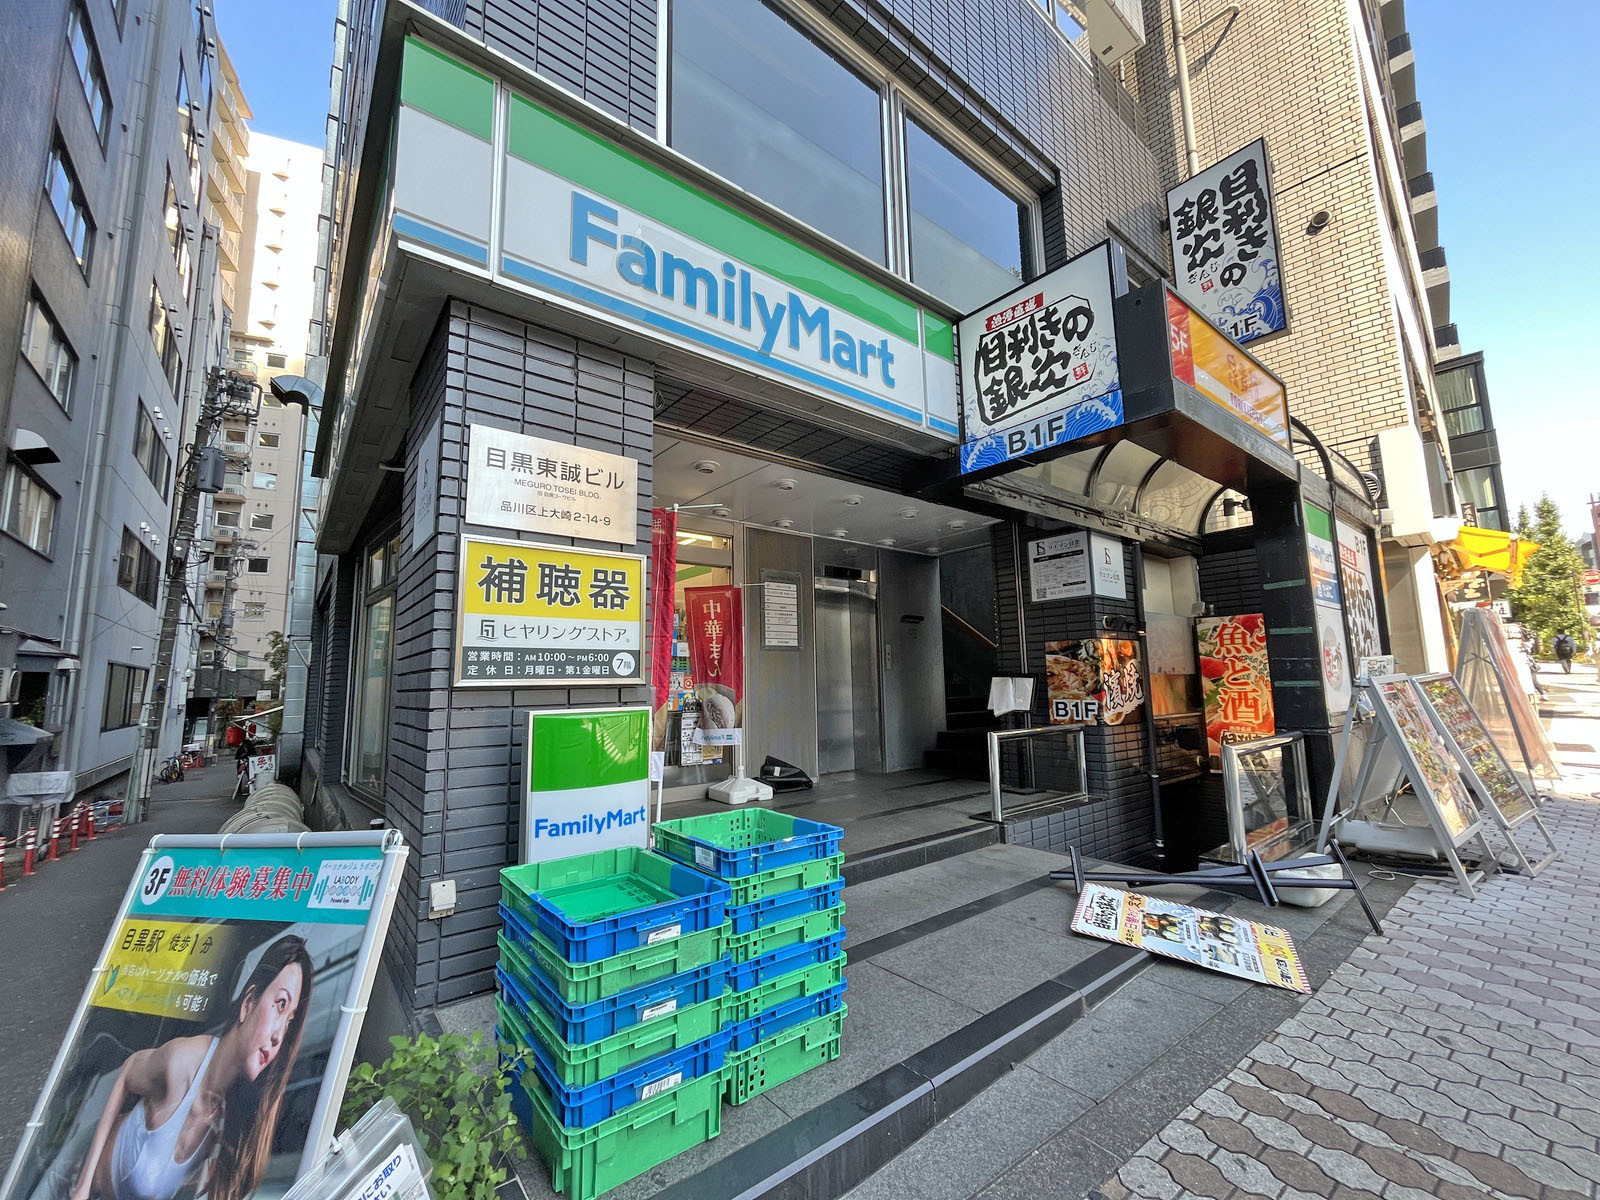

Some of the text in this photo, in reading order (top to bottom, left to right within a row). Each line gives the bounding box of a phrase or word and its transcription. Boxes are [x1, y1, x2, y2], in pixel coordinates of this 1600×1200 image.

[1173, 188, 1225, 273] 銀次
[1220, 158, 1268, 288] 目利きの
[569, 190, 896, 389] FamilyMart
[977, 305, 1095, 377] 目利きの
[1170, 323, 1188, 355] 5F
[983, 348, 1071, 420] 銀次
[1007, 414, 1065, 456] B1F
[486, 446, 625, 490] 目黒東誠ビル
[514, 477, 552, 492] MEGURO
[554, 485, 577, 497] TOSEI
[500, 501, 611, 526] 品川区上大崎2-14-9
[477, 555, 631, 610] 補聴器
[503, 624, 627, 642] ヒヤリングストア
[1213, 622, 1261, 723] 魚と酒
[1055, 701, 1099, 720] B1F
[535, 805, 646, 839] FamilyMart
[145, 868, 170, 896] 3F
[168, 864, 314, 902] 無料体験募集中
[121, 927, 213, 954] 目黒駅 徒歩1分
